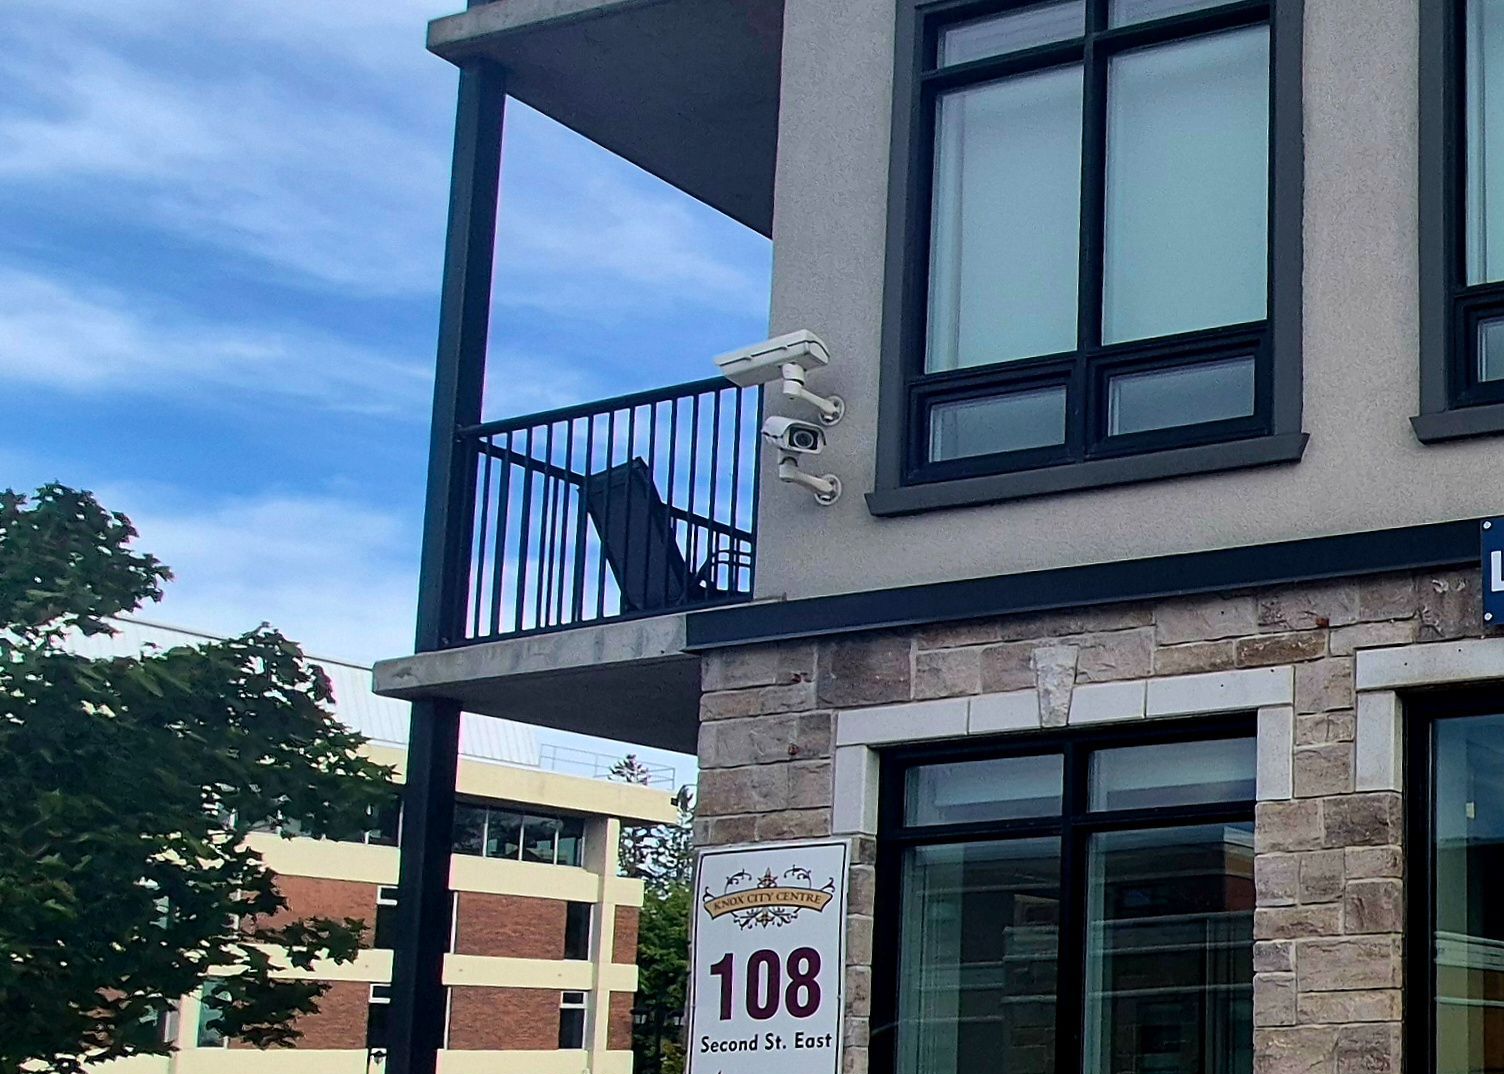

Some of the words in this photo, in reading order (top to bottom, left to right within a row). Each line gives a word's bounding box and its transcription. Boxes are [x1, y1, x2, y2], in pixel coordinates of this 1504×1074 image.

[713, 896, 745, 910] KNOX
[747, 893, 774, 904] CITY
[776, 892, 821, 905] CENTRE
[710, 947, 821, 1020] 108
[701, 1034, 758, 1053] Second
[765, 1033, 786, 1050] St.
[795, 1032, 832, 1048] East
